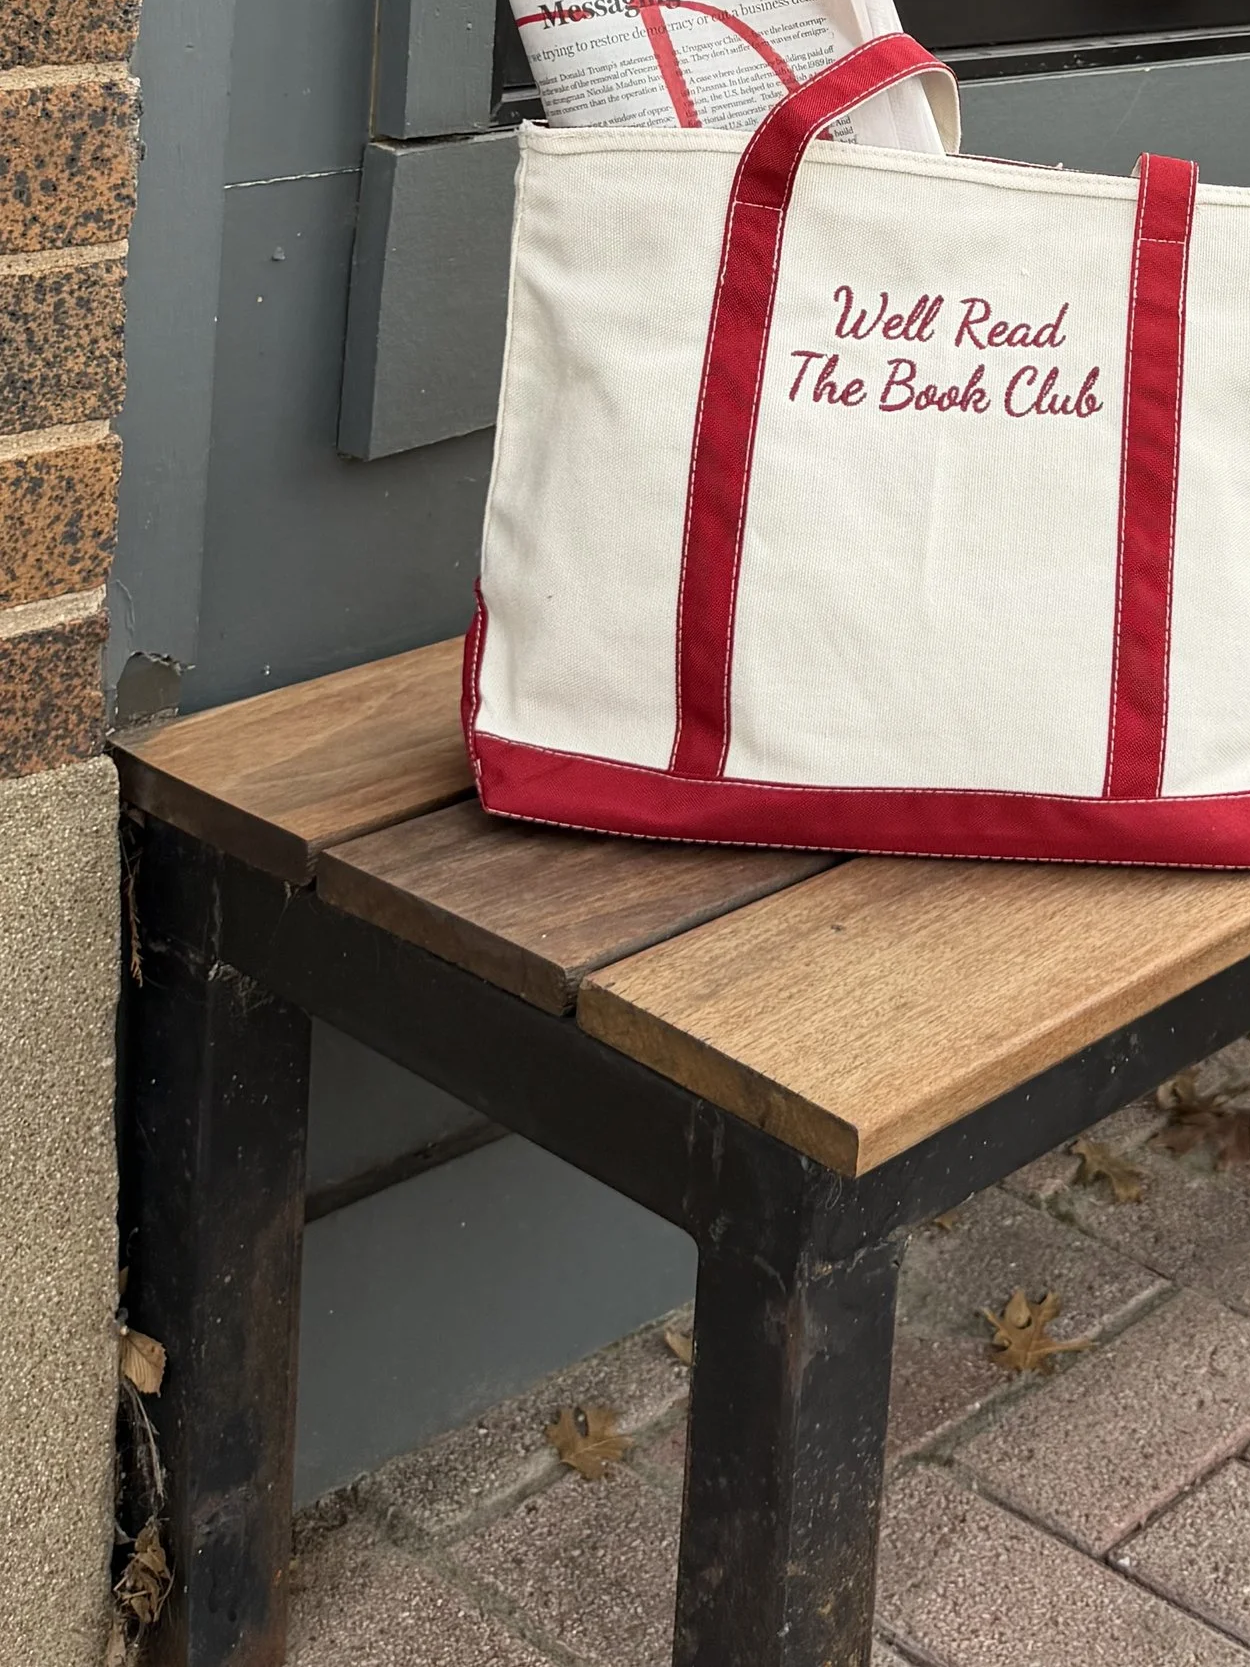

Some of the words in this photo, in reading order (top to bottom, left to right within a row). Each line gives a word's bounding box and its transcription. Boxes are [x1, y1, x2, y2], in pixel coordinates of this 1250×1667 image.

[542, 45, 575, 62] trying
[575, 42, 588, 52] to
[590, 33, 630, 49] restore
[631, 15, 696, 43] democracy
[696, 16, 708, 25] or
[682, 42, 713, 53] Uruguay
[769, 26, 781, 34] the
[781, 22, 799, 31] least
[799, 17, 827, 27] corrup-
[691, 53, 710, 62] They
[711, 48, 729, 58] don't
[792, 31, 800, 40] of
[801, 28, 829, 38] emigra-
[559, 69, 585, 81] Donald
[587, 61, 617, 75] Trump's
[689, 77, 696, 85] A
[696, 75, 711, 83] case
[712, 70, 735, 79] where
[807, 47, 823, 60] paid
[824, 45, 834, 54] off
[590, 71, 619, 85] removal
[620, 69, 628, 78] of
[615, 78, 646, 90] Maduro
[737, 76, 749, 84] the
[589, 99, 607, 107] than
[607, 94, 620, 103] the
[621, 87, 657, 100] operation
[710, 93, 722, 101] the
[723, 89, 739, 98] U.S.
[740, 83, 765, 95] helped
[638, 108, 646, 117] of
[711, 97, 757, 113] government.
[727, 106, 766, 119] democratic
[834, 285, 944, 342] Well
[954, 297, 1069, 350] Read
[789, 350, 867, 406] The
[879, 358, 991, 413] Book
[1004, 365, 1104, 418] Club
